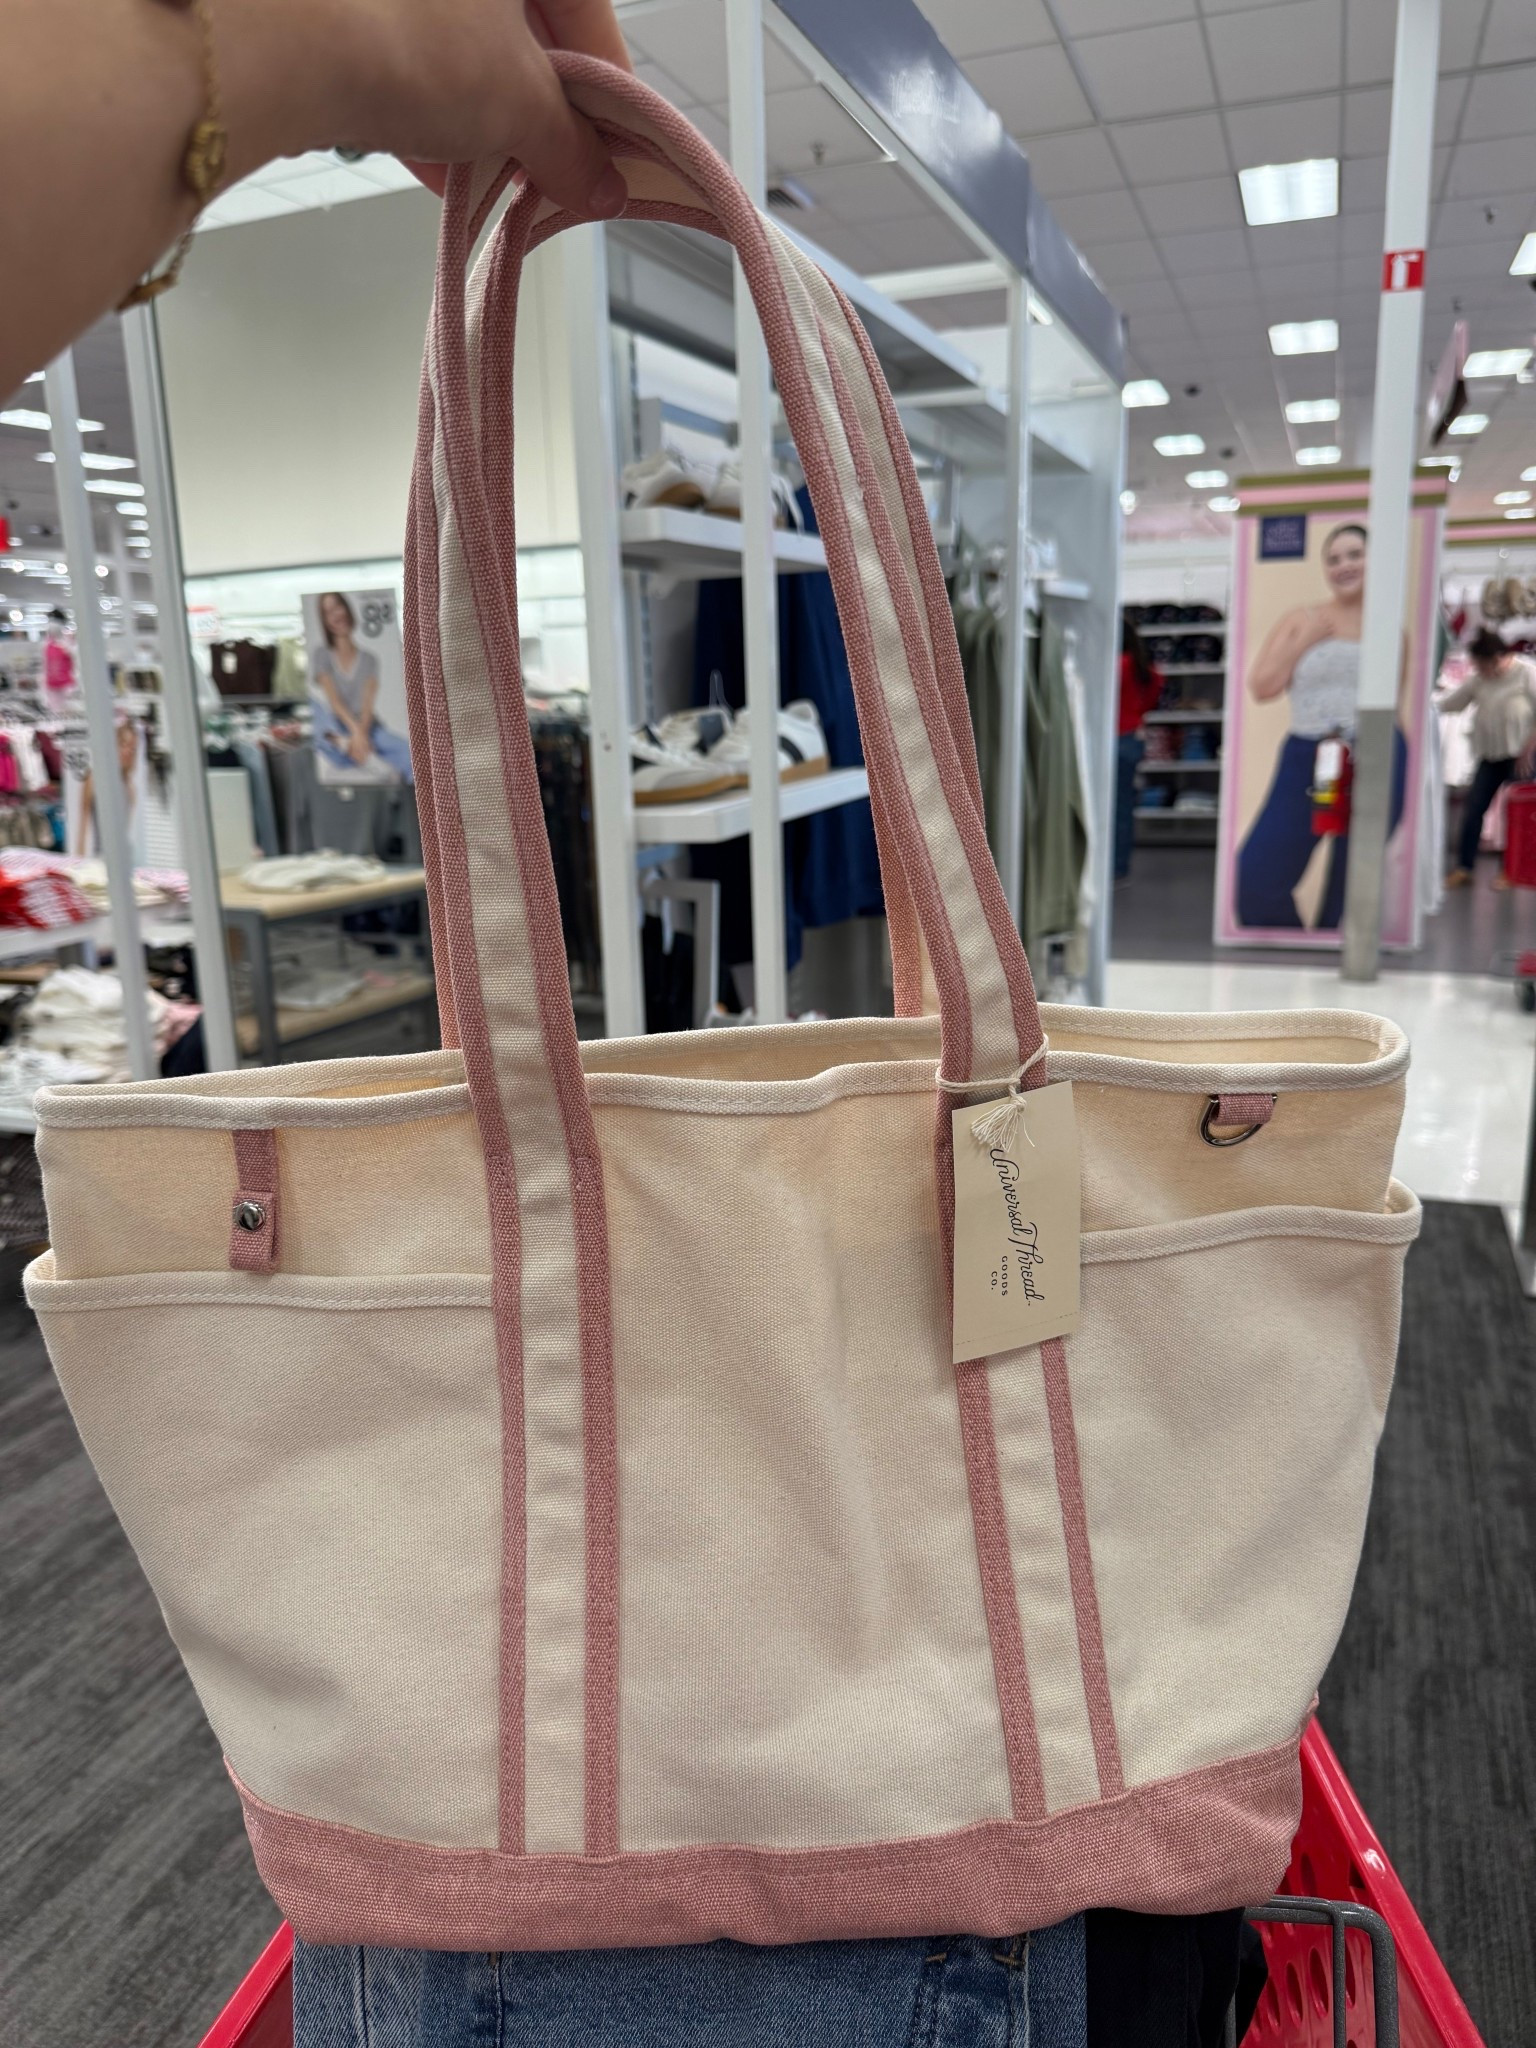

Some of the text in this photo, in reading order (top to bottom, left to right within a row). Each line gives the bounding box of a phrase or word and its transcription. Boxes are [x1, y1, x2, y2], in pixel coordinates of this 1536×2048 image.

[989, 1148, 1045, 1300] Universal Thread
[990, 1270, 999, 1291] CO.
[1001, 1255, 1009, 1296] GOODS
